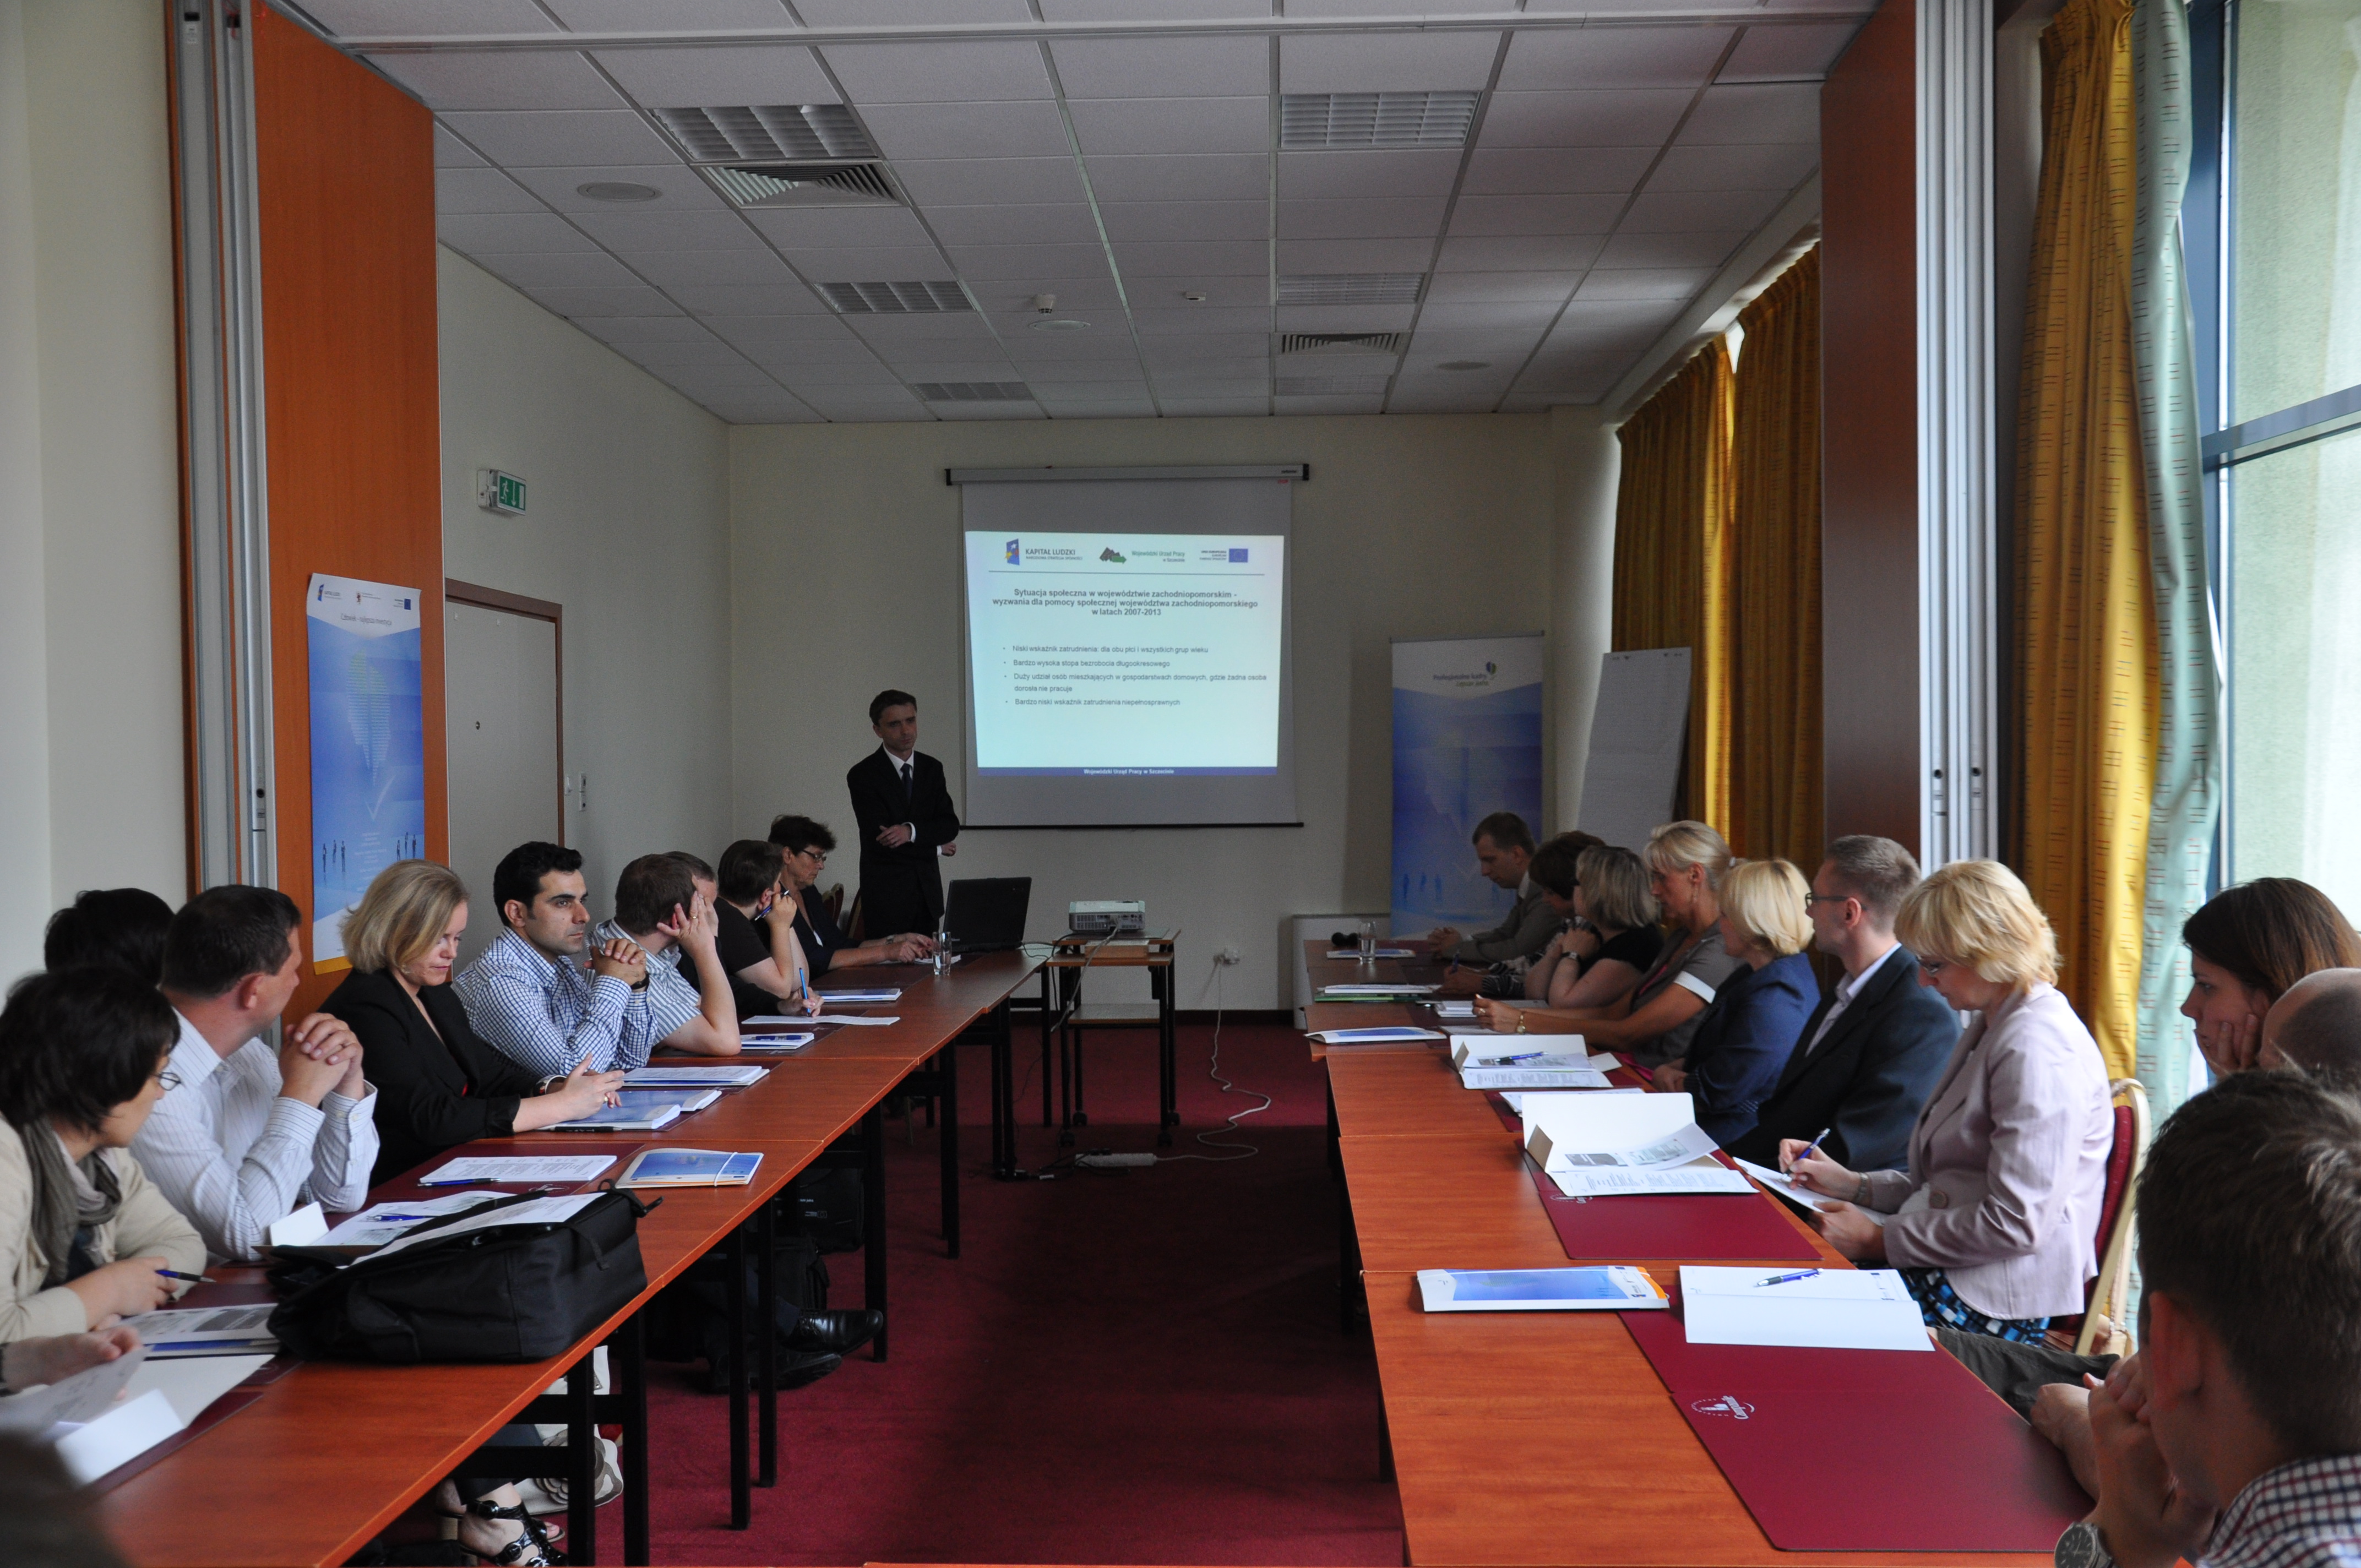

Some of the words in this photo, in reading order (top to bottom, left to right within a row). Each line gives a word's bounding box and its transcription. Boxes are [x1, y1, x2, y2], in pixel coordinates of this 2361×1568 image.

[1014, 589, 1047, 597] Sytuacja
[1048, 589, 1087, 597] społeczna
[1097, 590, 1150, 598] województwie
[993, 598, 1030, 607] wyzwania
[1077, 599, 1117, 608] społecznej
[1119, 600, 1169, 608] województwa
[1171, 600, 1258, 609] zachodniopomorskiego
